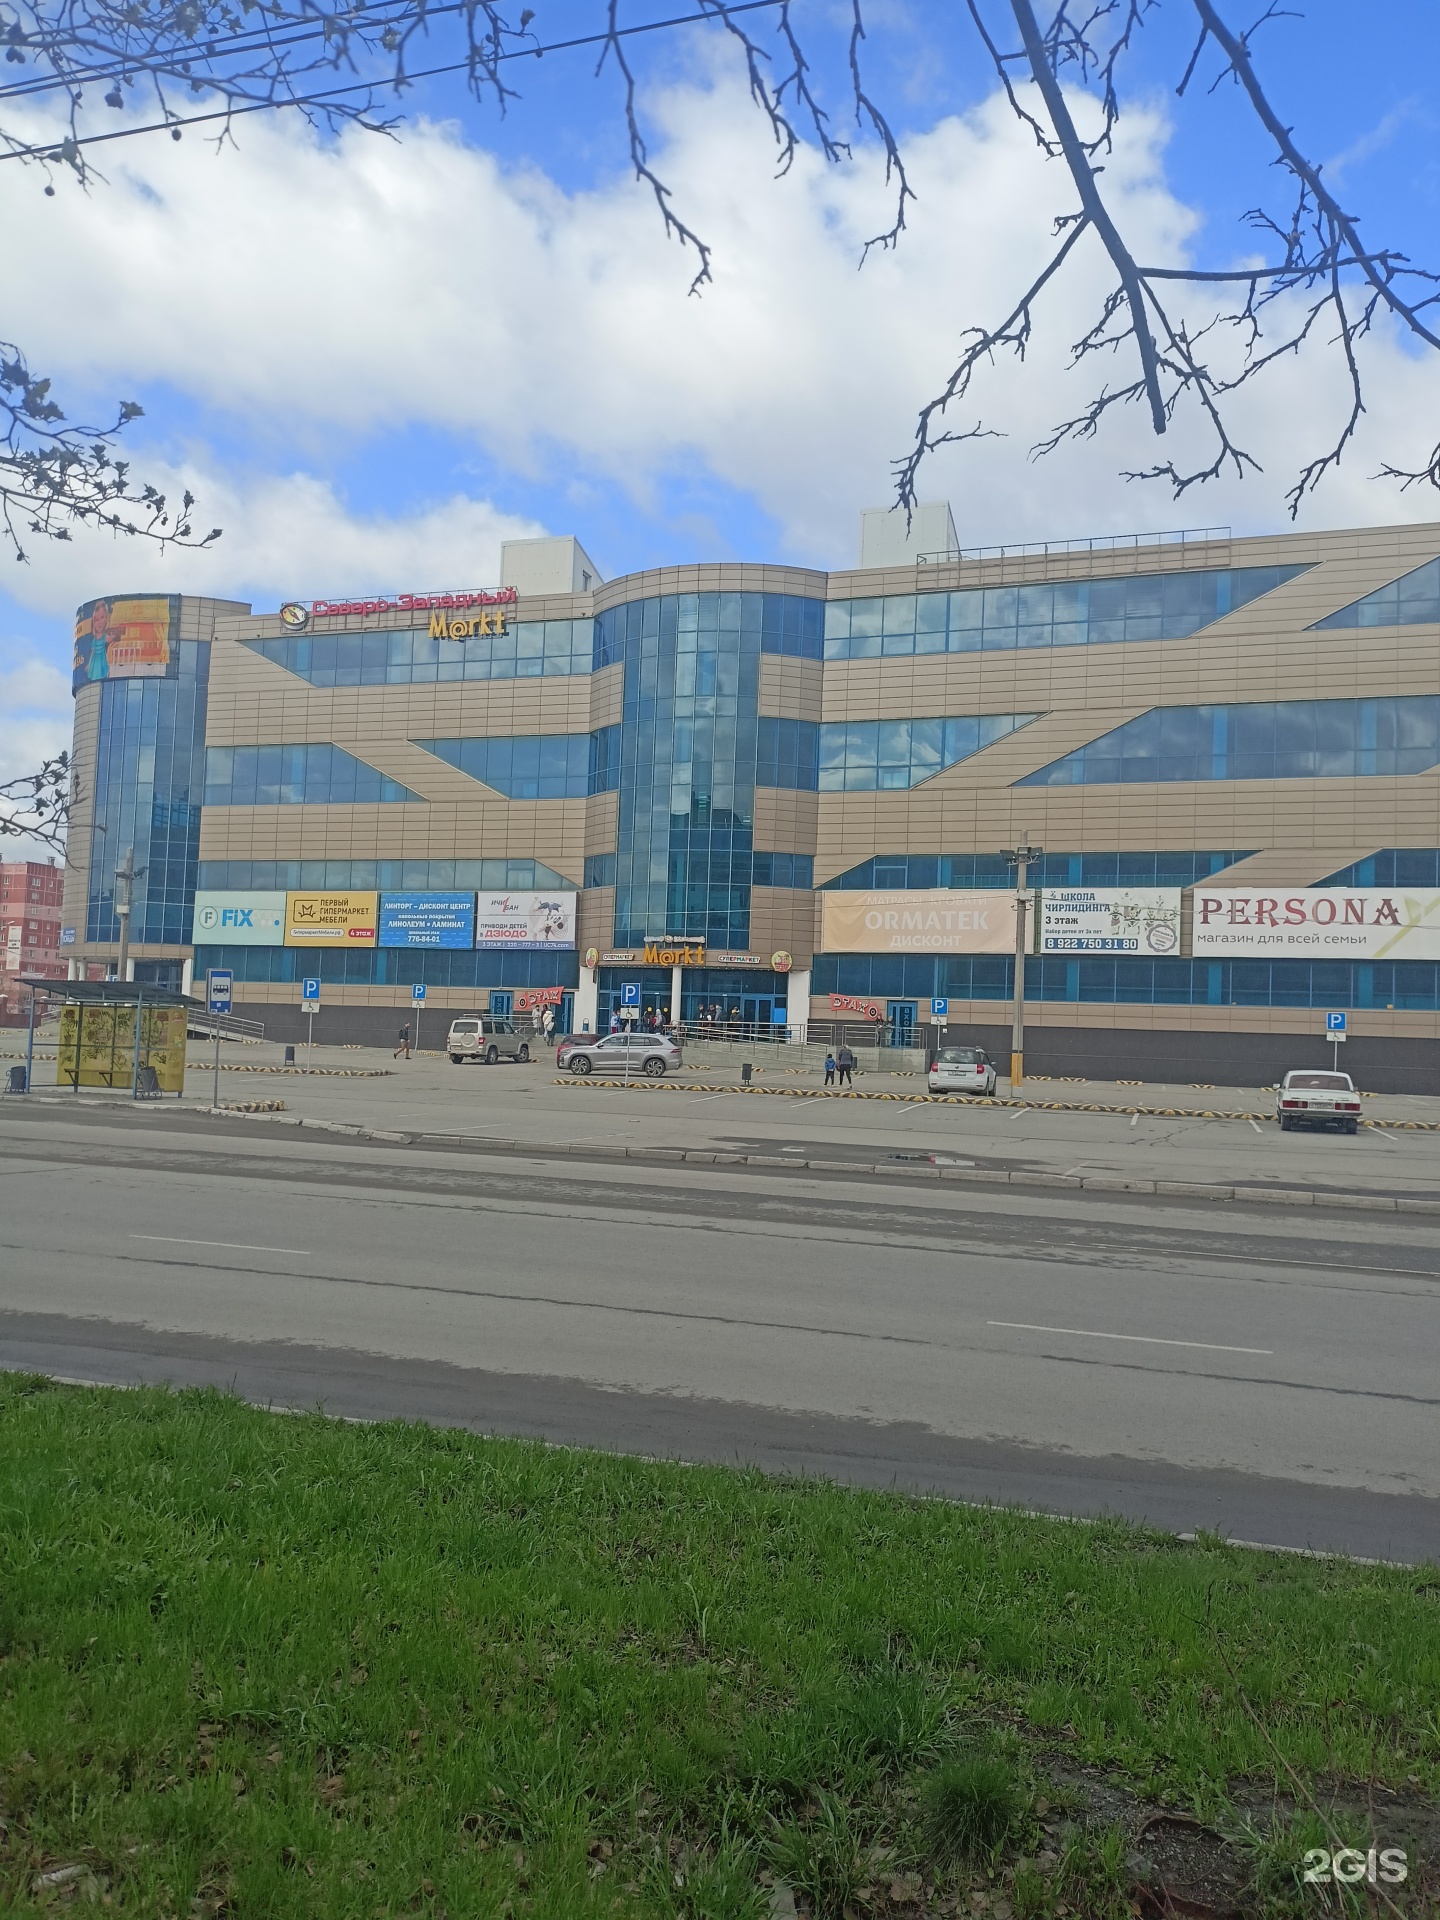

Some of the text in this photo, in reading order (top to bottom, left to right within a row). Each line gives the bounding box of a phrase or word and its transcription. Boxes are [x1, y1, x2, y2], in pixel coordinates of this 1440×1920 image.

[312, 587, 517, 617] Северо-Западный
[428, 609, 505, 641] M@rkt
[867, 895, 987, 905] МАТРАСЫ КРОВАТИ
[1061, 892, 1095, 901] ШКОЛА
[320, 898, 348, 907] ПЕРВЫЙ
[418, 903, 449, 911] ДИСКОНТ
[449, 903, 471, 911] ЦЕНТР
[1045, 903, 1111, 913] ЧИРЛИДИНГА
[319, 907, 370, 915] ГИПЕРМАРКЕТ
[1198, 897, 1402, 928] PERSONA
[319, 916, 348, 924] МЕБЕЛИ
[387, 920, 426, 928] ЛИНОЛЕУМ
[864, 910, 989, 930] ORMATEK
[1045, 916, 1079, 925] 3 этаж
[508, 922, 528, 930] ДЕТЕЙ
[484, 929, 528, 939] ДЗЮДО
[1197, 933, 1367, 945] магазин для всей семьи
[889, 935, 962, 948] ДИСКОНТ
[1047, 938, 1137, 949] 8 922 750 31 80
[643, 943, 705, 966] M@rkt
[718, 955, 760, 963] СУПЕРМАРКЕТ
[306, 980, 317, 997] P
[414, 985, 424, 998] P
[625, 985, 636, 1003] P
[933, 999, 945, 1013] P
[1330, 1013, 1342, 1028] P
